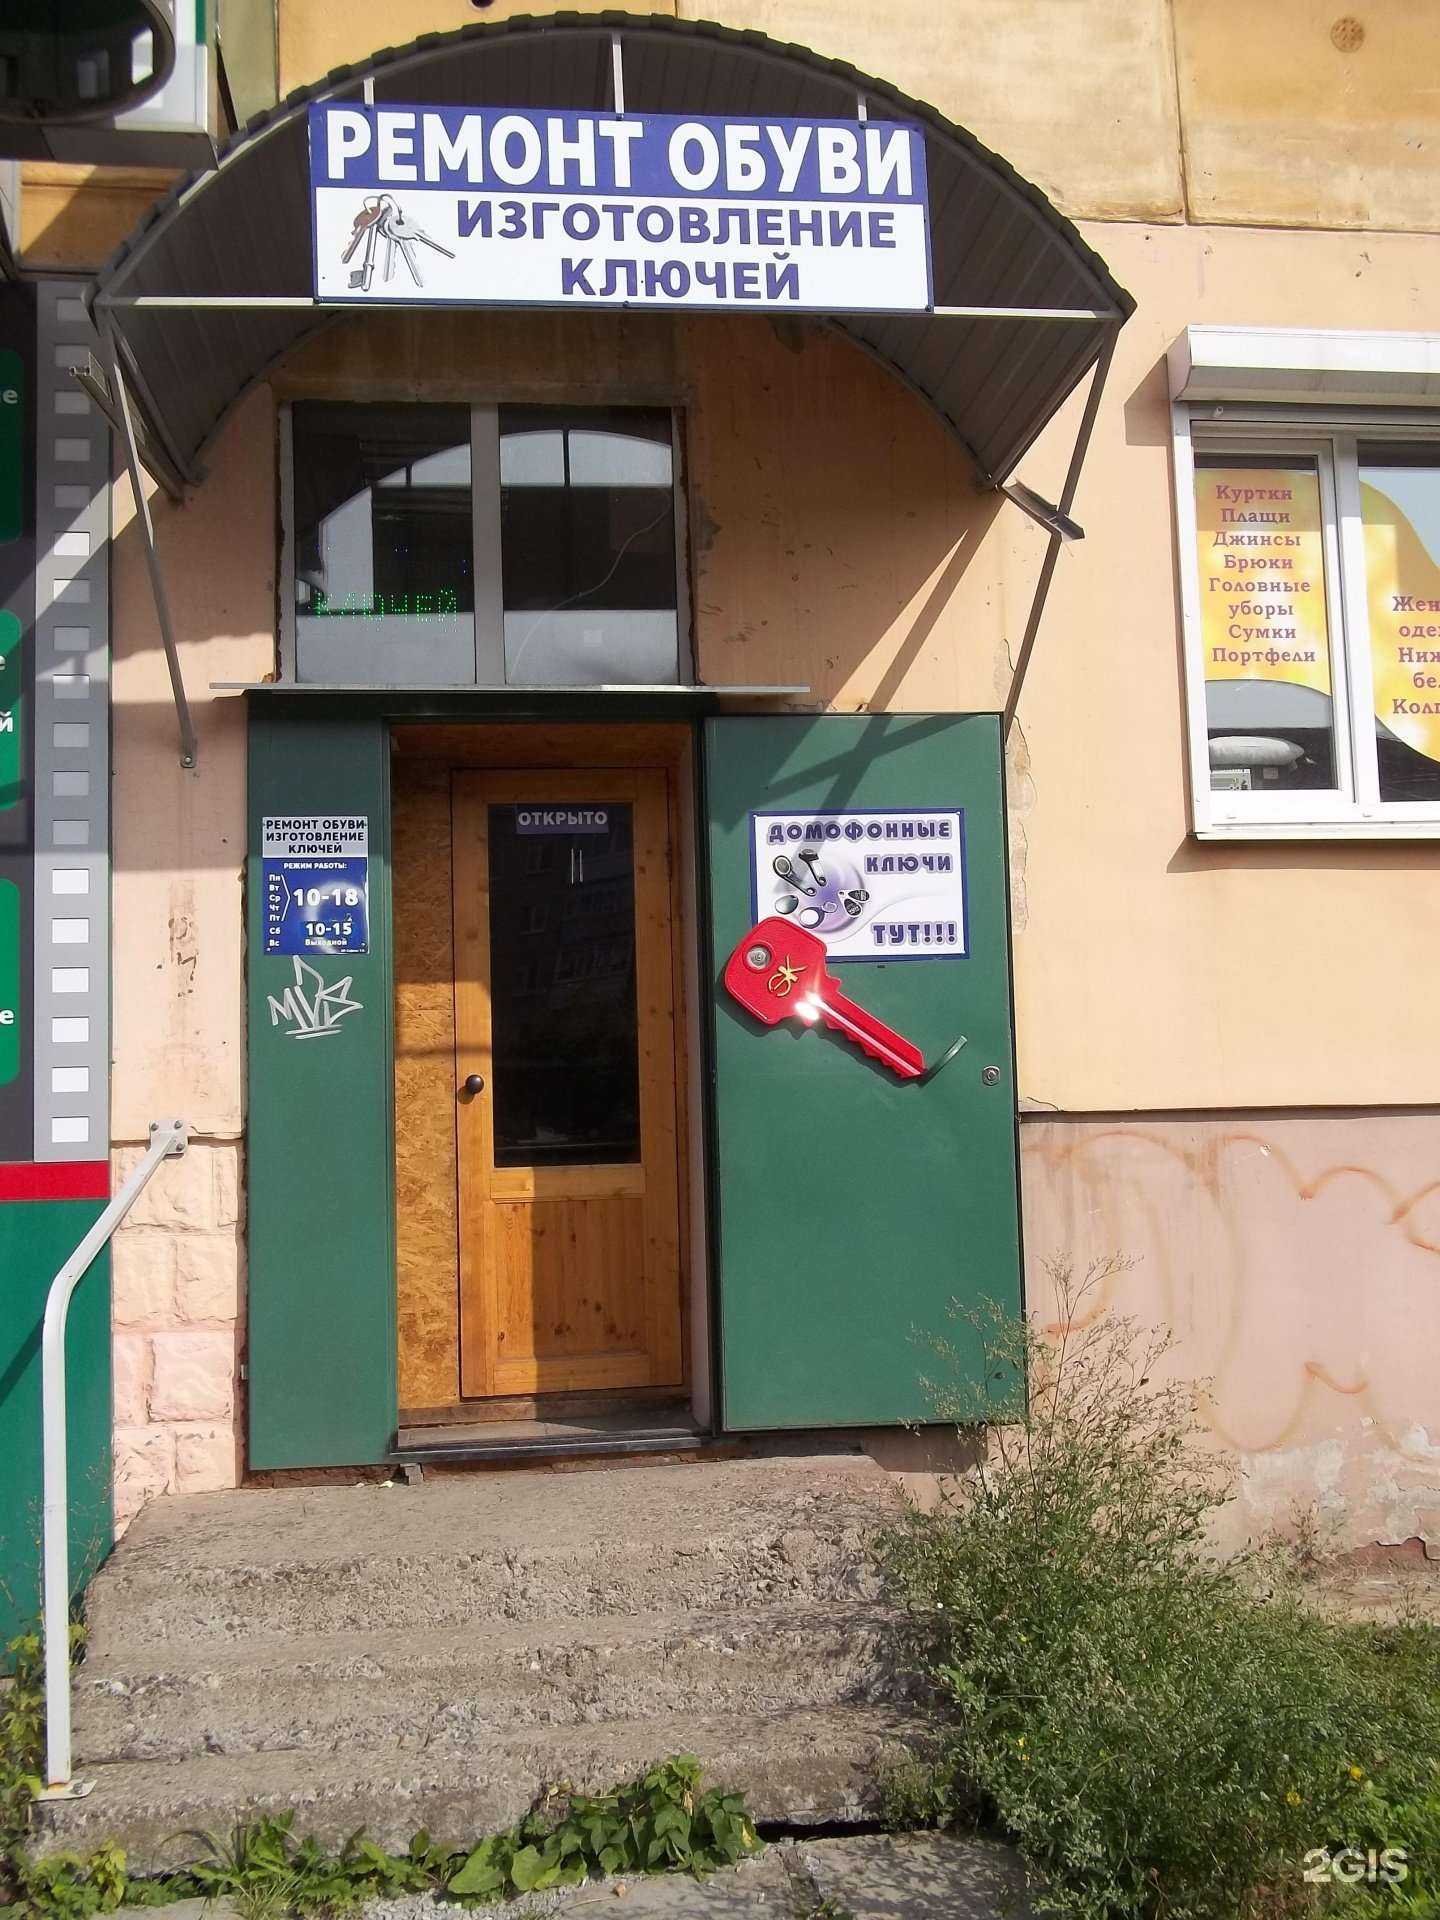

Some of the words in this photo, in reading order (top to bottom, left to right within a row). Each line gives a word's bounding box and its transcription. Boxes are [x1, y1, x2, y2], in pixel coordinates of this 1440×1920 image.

[326, 109, 646, 189] РЕМОНТ
[667, 122, 915, 197] ОБУВИ
[456, 199, 898, 250] ИЗГОТОВЛЕНИЕ
[560, 252, 801, 301] КЛЮЧЕЙ
[1215, 484, 1293, 503] Куртки
[1220, 507, 1291, 525] Плащи
[1212, 530, 1302, 548] Джинсы
[1223, 554, 1294, 573] Брюки
[1208, 577, 1312, 593] Головные
[1228, 600, 1295, 620] уборы
[1228, 624, 1297, 643] Сумки
[1398, 624, 1440, 639] оде
[1211, 647, 1316, 667] Портфели
[1412, 671, 1440, 689] бе
[266, 819, 319, 830] РЕМОНТ
[322, 819, 365, 830] ОБУВИ
[517, 811, 608, 826] ОТКРЫТО
[266, 832, 365, 842] ИЗГОТОВЛЕНИЕ
[768, 820, 952, 843] ДОМОФОННЫЕ
[288, 841, 342, 854] КЛЮЧЕЙ
[283, 862, 313, 870] РЕЖИМ
[314, 862, 348, 870] РАБОТЫ:
[865, 855, 952, 873] КЛЮЧИ
[269, 874, 281, 882] Пн
[269, 884, 280, 892] Вт
[269, 894, 281, 903] Ср
[293, 888, 359, 907] 10-18
[269, 904, 280, 912] Чт
[269, 914, 281, 922] Пт
[269, 926, 281, 935] Сб
[305, 922, 352, 936] 10-15
[872, 922, 957, 944] ТУТ!!!
[269, 939, 280, 947] Вс
[304, 938, 348, 946] Выходной
